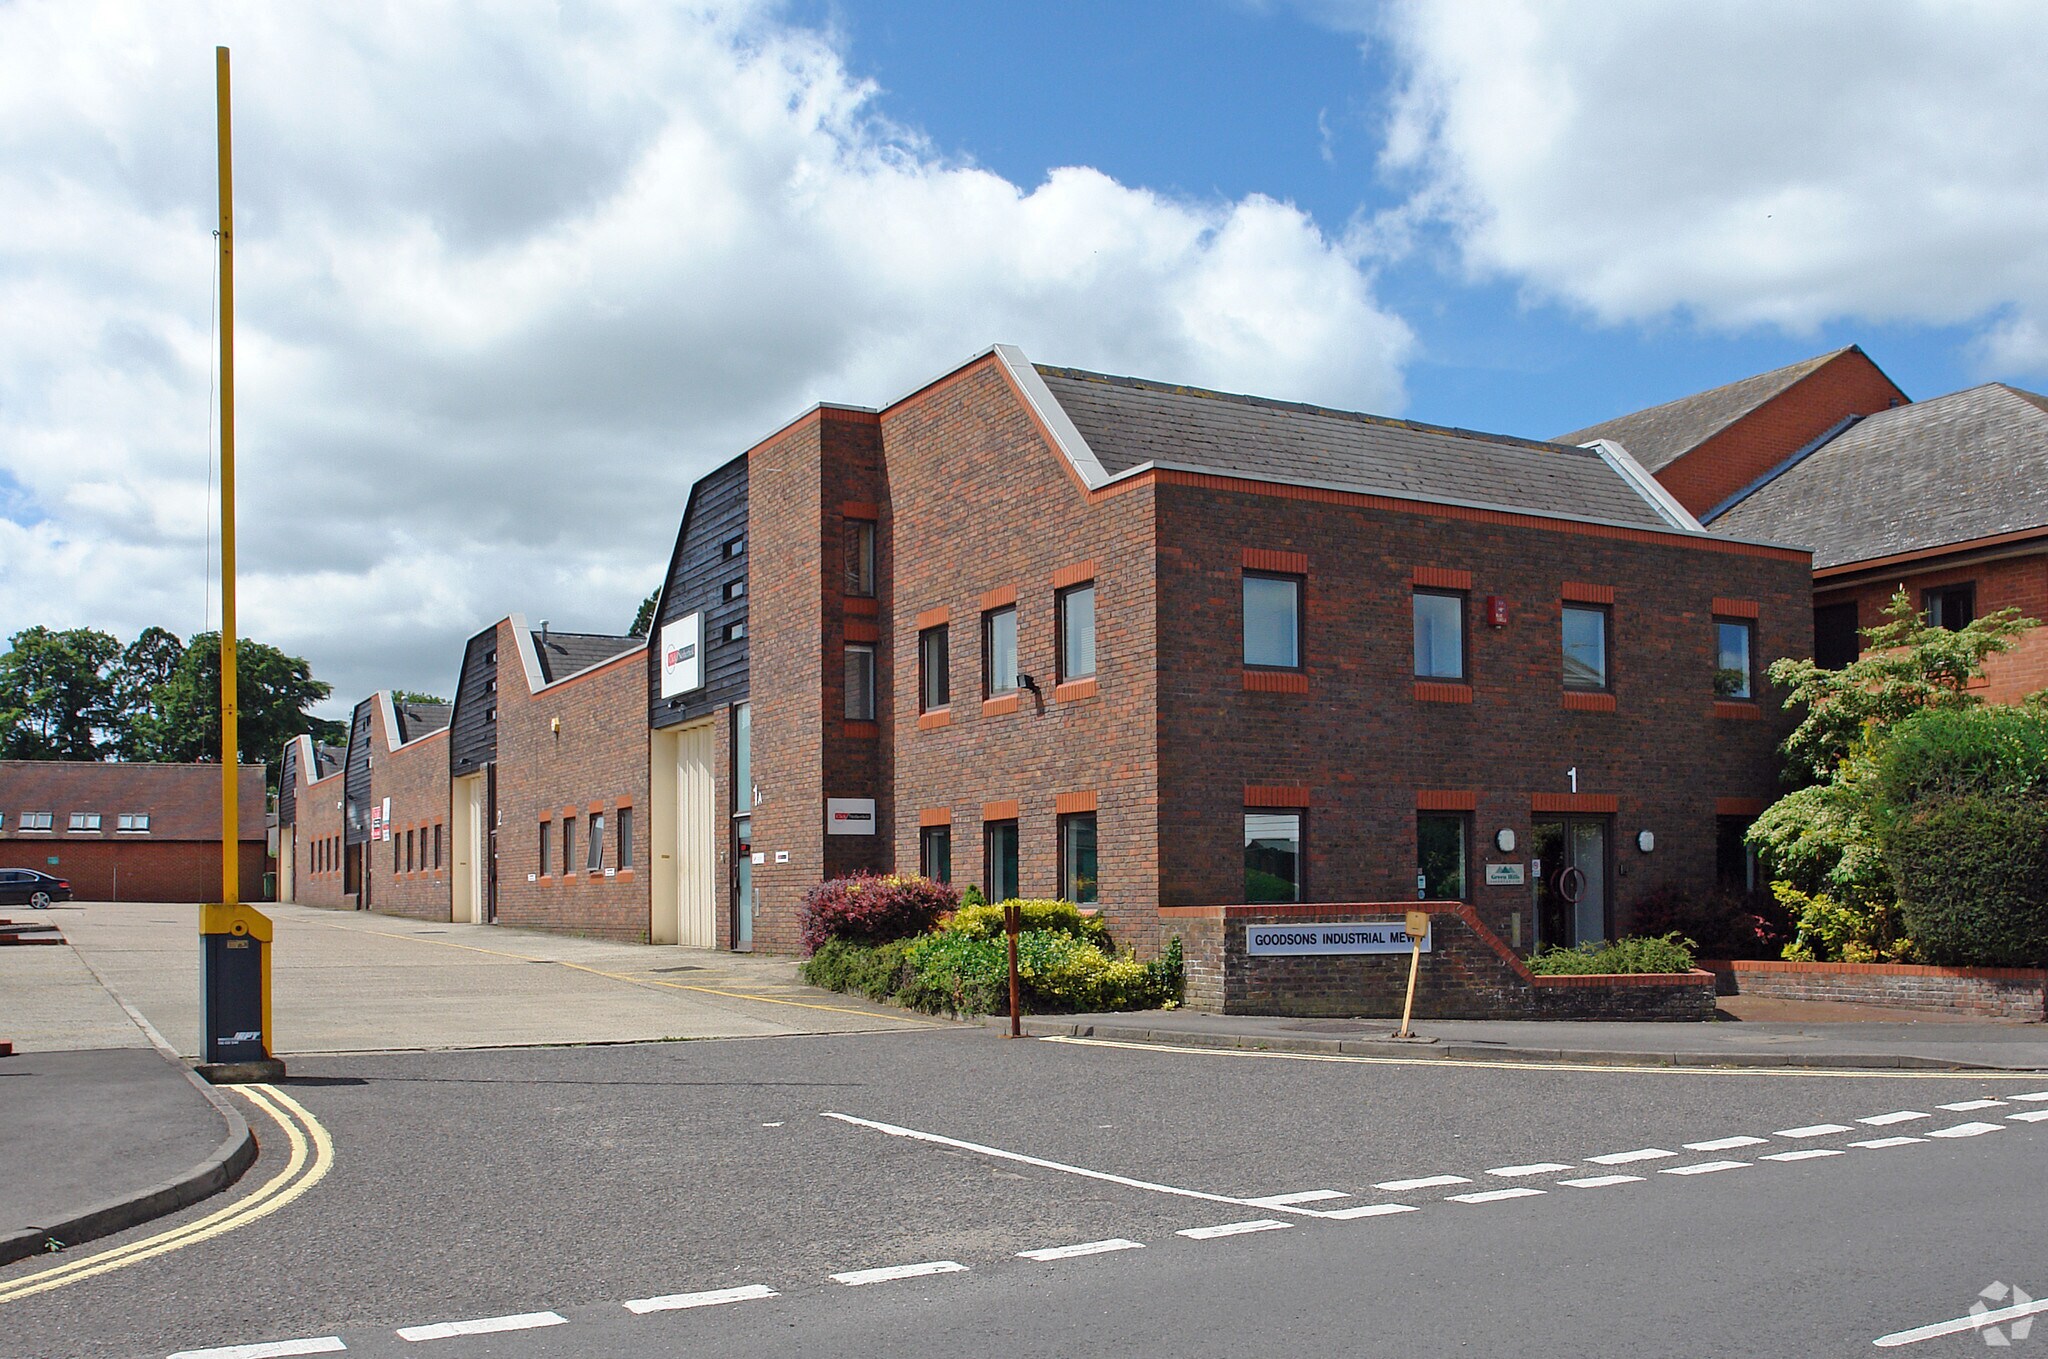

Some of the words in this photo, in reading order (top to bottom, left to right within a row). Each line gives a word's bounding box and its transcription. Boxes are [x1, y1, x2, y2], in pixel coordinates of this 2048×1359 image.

[1567, 767, 1577, 793] 1
[753, 784, 763, 806] 1A
[1255, 933, 1317, 946] GOODSONS
[1322, 932, 1386, 945] INDUSTRIAL
